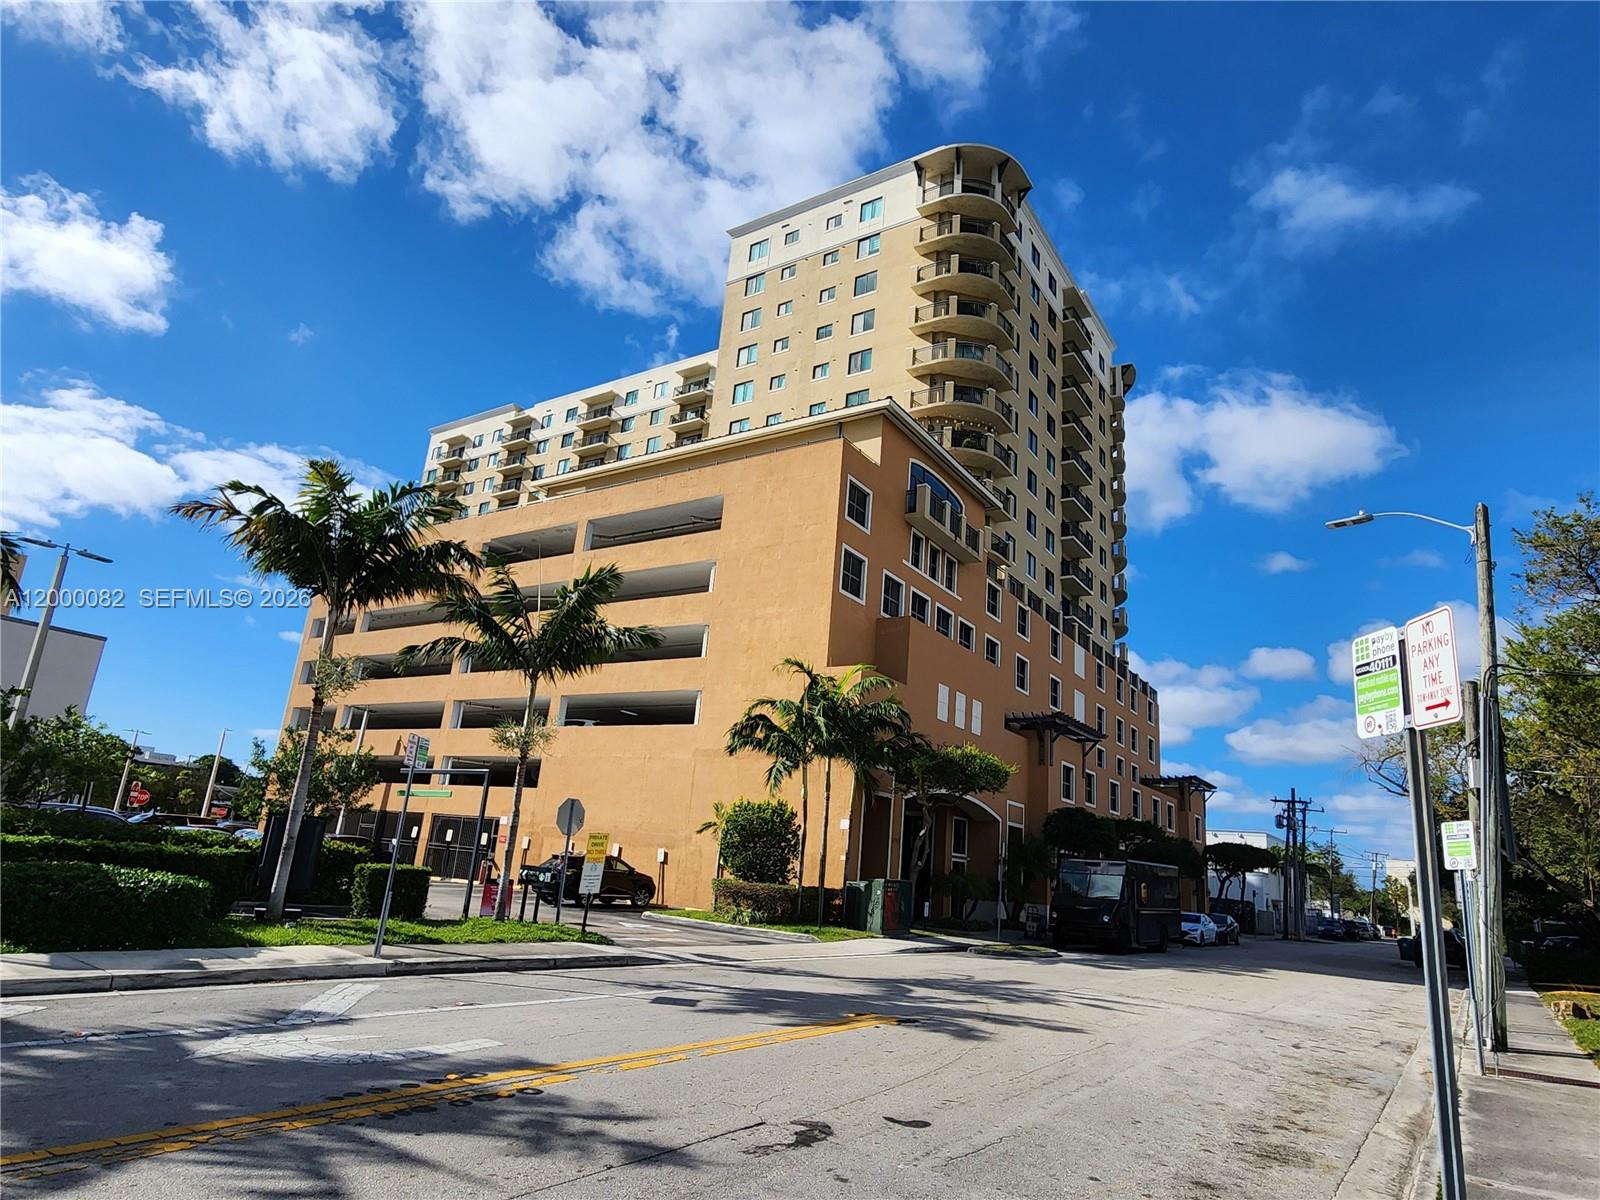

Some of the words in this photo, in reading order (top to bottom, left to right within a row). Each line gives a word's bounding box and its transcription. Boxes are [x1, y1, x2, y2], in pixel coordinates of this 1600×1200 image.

[1421, 620, 1435, 637] NO
[1372, 643, 1396, 659] phone
[1410, 632, 1450, 658] PARKING
[1368, 658, 1394, 674] 40111
[1422, 653, 1441, 673] ANY
[1422, 670, 1445, 690] TIME
[1440, 686, 1453, 699] ZONE
